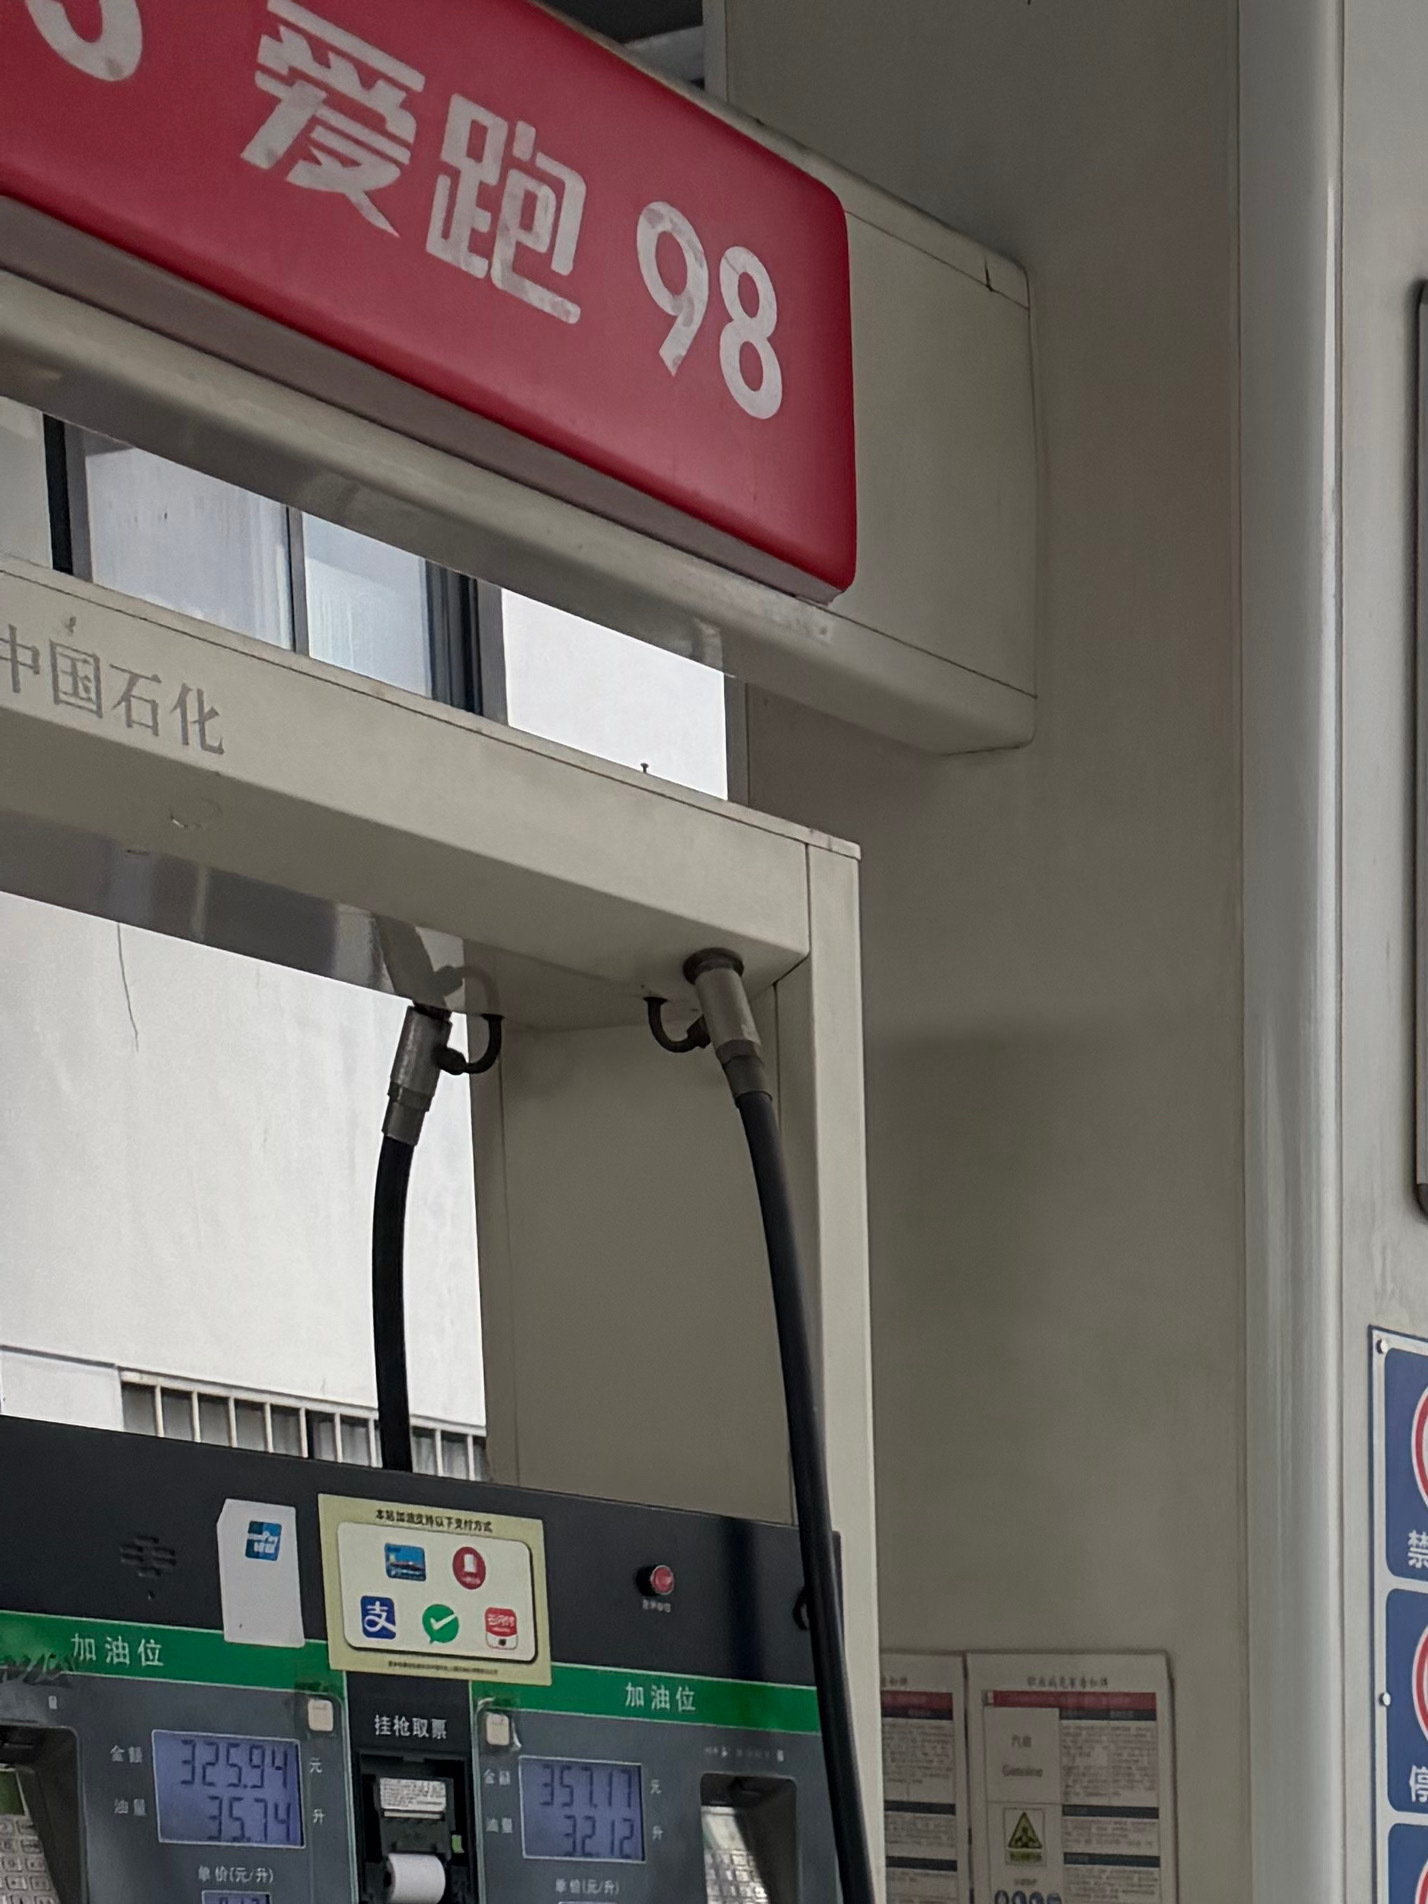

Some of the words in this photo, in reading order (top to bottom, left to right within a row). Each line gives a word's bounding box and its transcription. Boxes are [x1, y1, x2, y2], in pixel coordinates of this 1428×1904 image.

[241, 0, 587, 325] 爱跑
[636, 202, 782, 420] 98
[0, 624, 224, 756] 中国石化
[70, 1634, 164, 1667] 加油位
[625, 1682, 696, 1712] 加油位
[180, 1739, 289, 1790] 325.94
[540, 1766, 633, 1809] 357.17
[206, 1795, 292, 1843] 35.74
